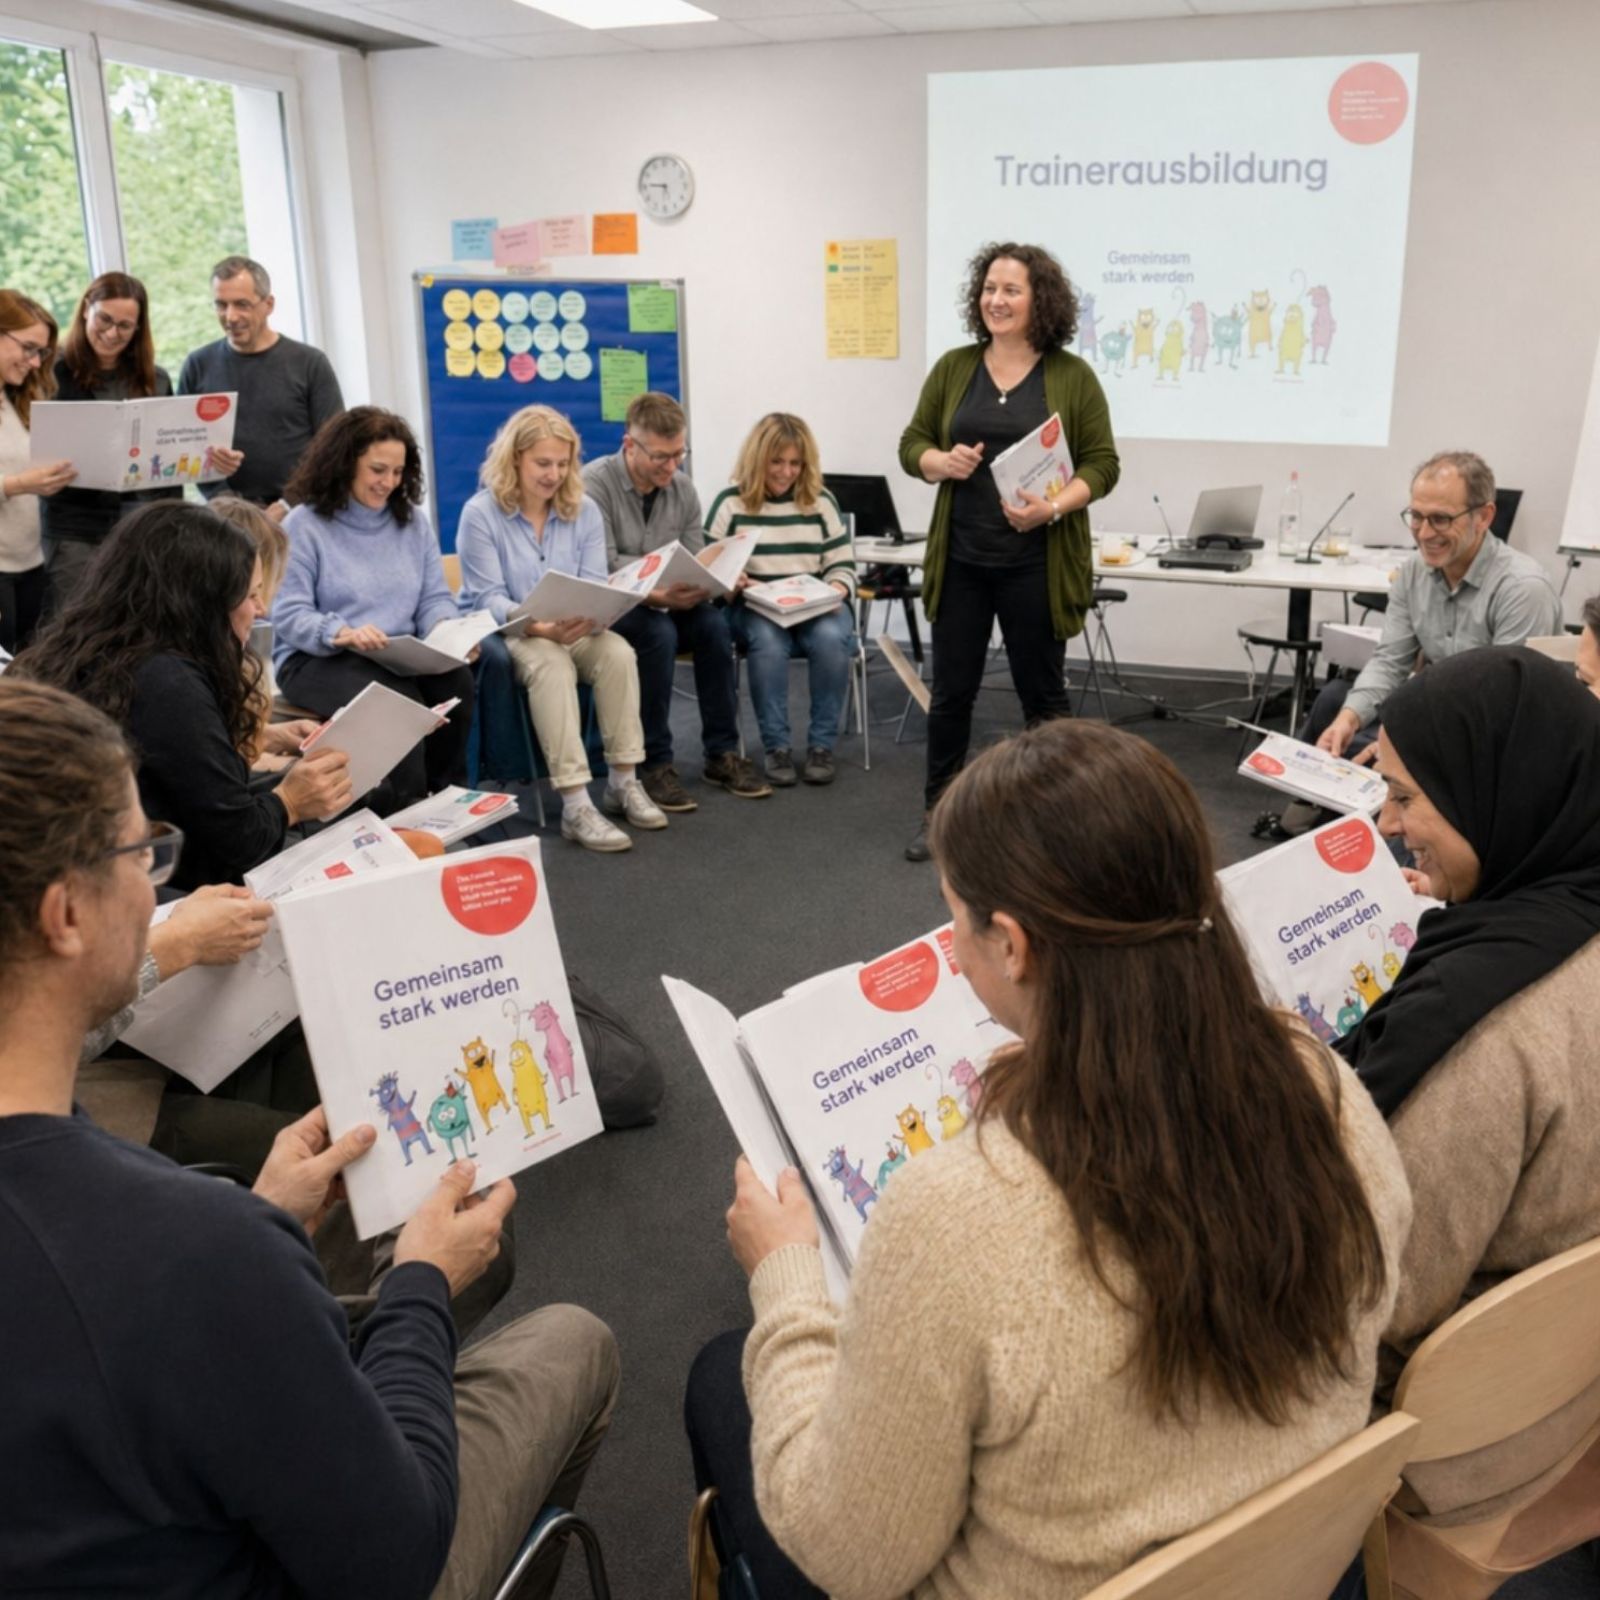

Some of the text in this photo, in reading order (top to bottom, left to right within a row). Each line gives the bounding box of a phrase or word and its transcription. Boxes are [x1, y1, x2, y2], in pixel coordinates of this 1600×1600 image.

[994, 151, 1329, 192] Trainerausbildung
[1102, 269, 1195, 284] stark werden
[1107, 250, 1191, 266] Gemeinsam
[1279, 888, 1365, 943] Gemeinsam
[1287, 901, 1382, 966] stark werden
[374, 953, 505, 1003] Gemeinsam
[379, 975, 520, 1030] stark werden
[813, 1028, 919, 1090] Gemeinsam
[820, 1042, 937, 1114] stark werden
